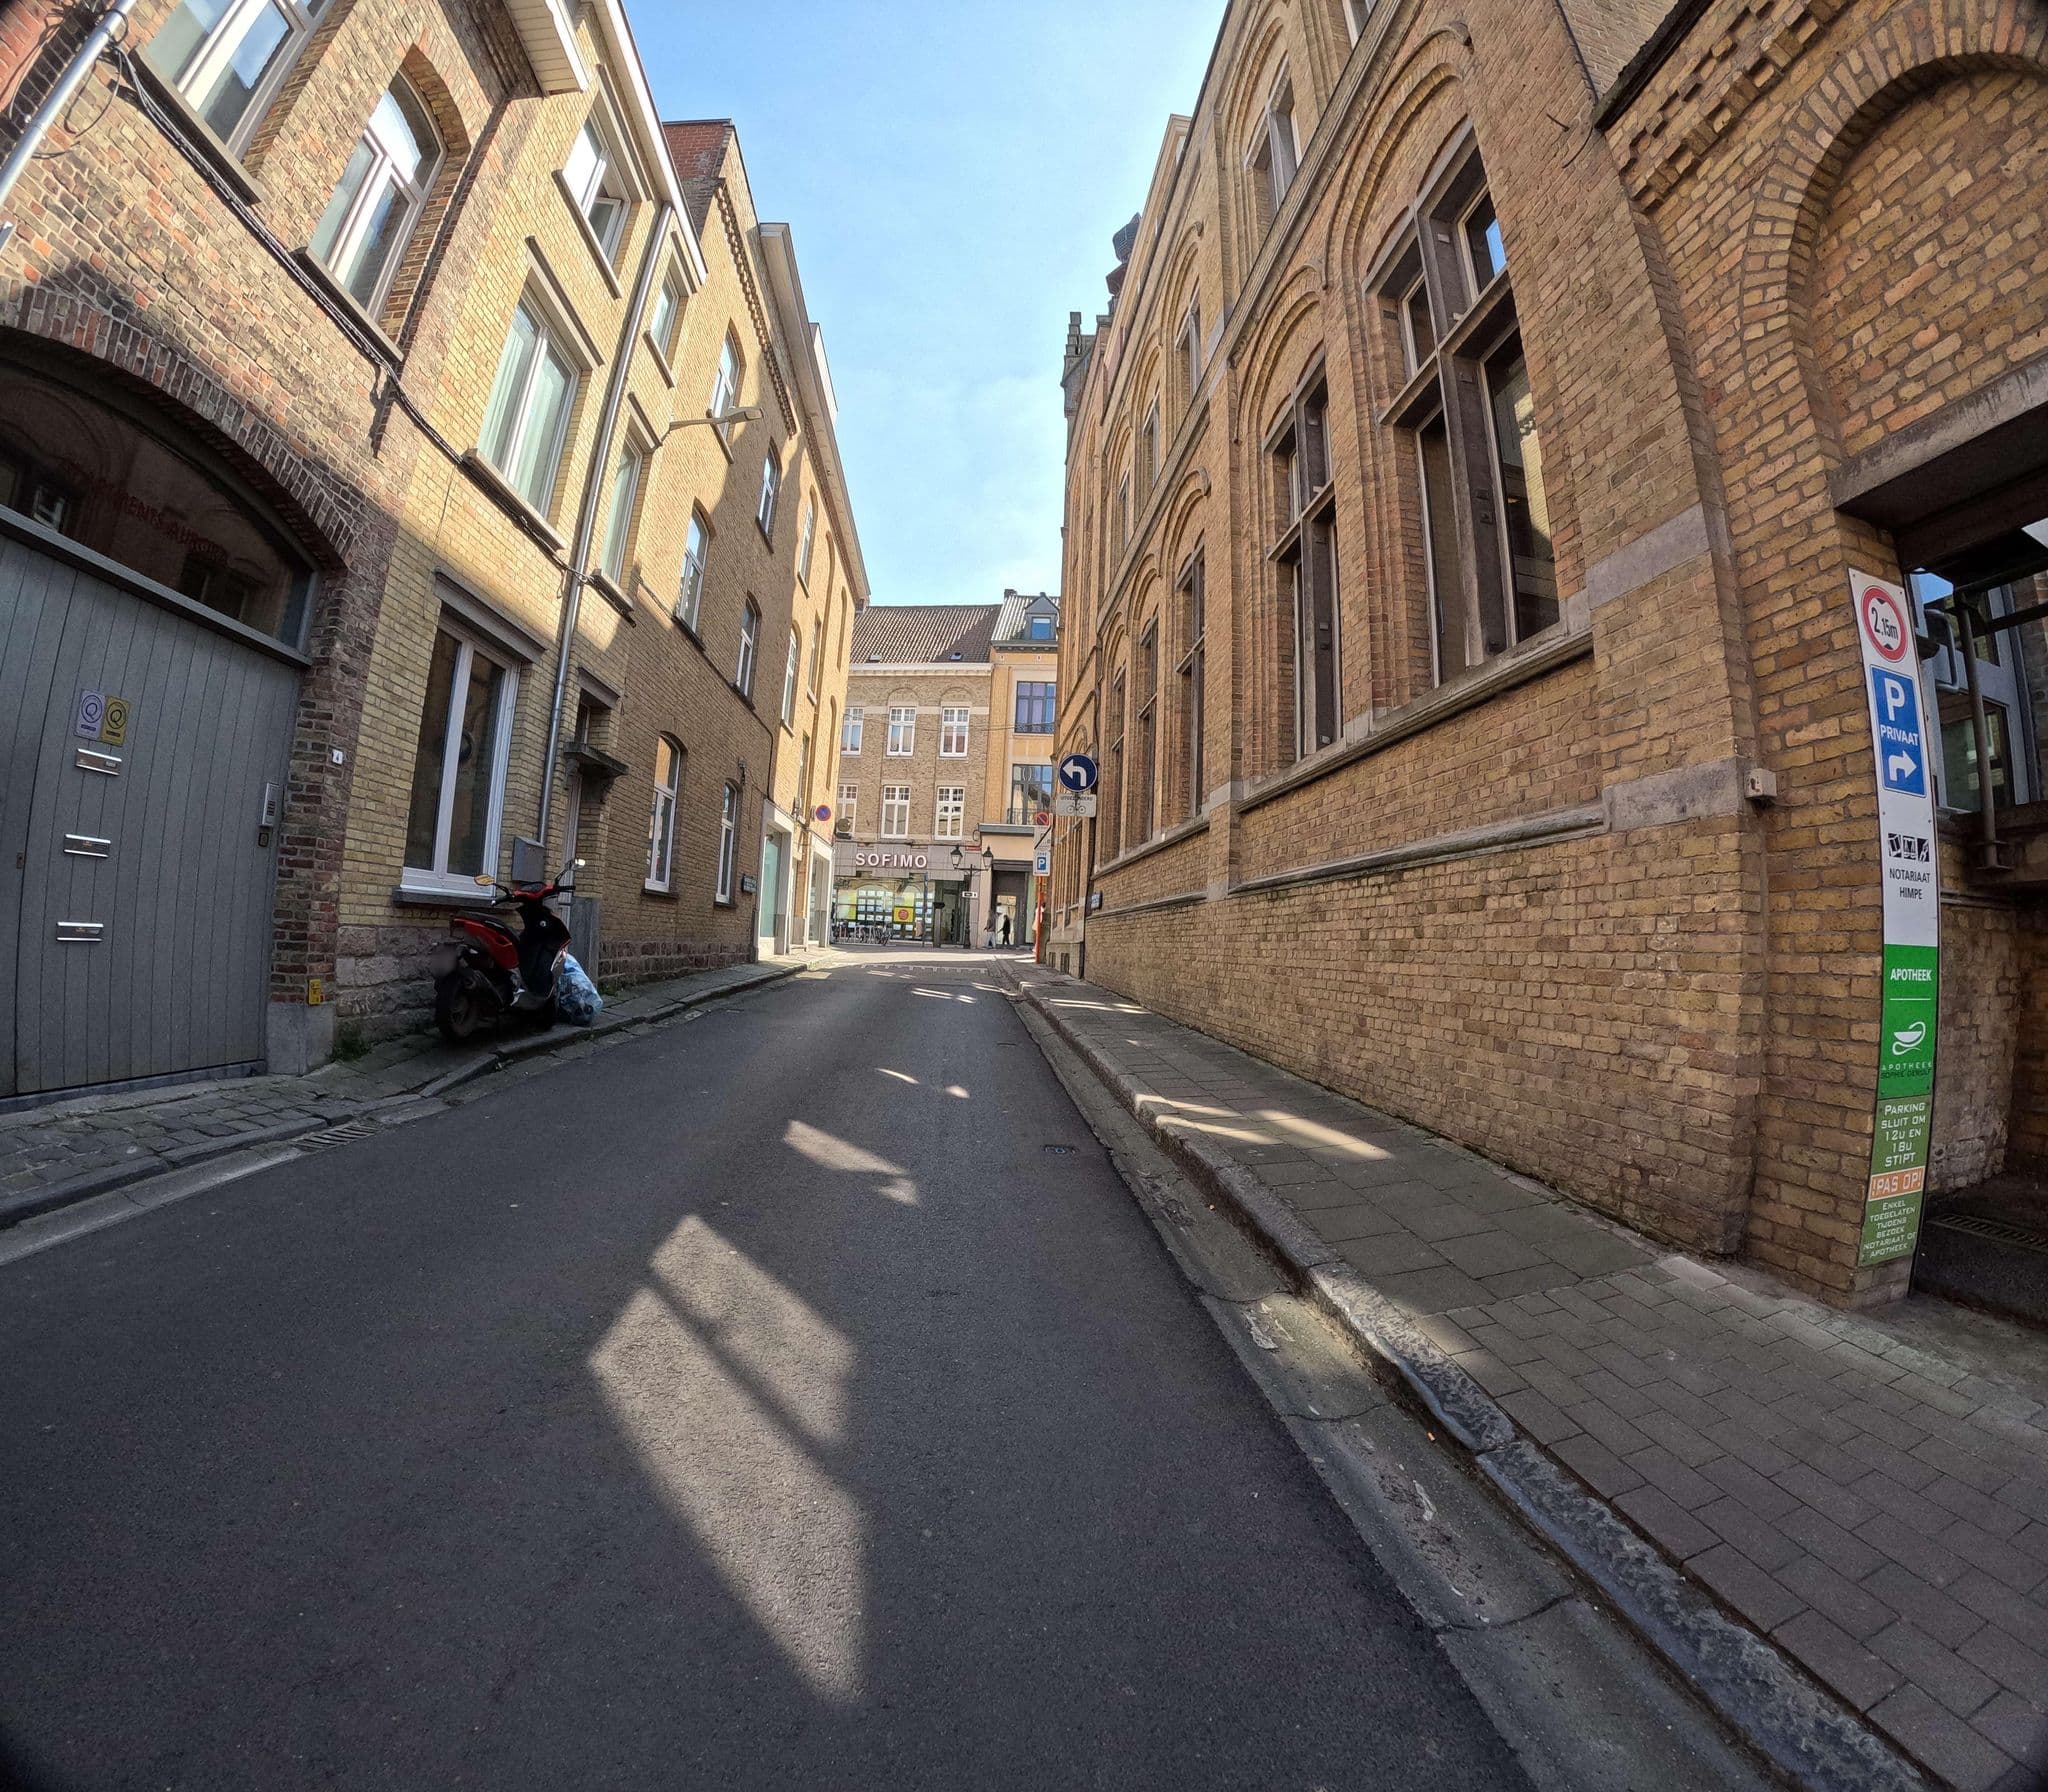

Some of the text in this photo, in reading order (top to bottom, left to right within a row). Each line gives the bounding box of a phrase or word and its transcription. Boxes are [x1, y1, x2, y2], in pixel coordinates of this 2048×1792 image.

[1884, 677, 1905, 721] P
[1880, 723, 1919, 746] PRIVAAT
[855, 852, 927, 868] SOFIMO
[1889, 868, 1931, 883] NOTARIAAT
[1899, 886, 1923, 900] HIMPE
[1890, 968, 1932, 982] APOTHEEK
[1884, 1102, 1926, 1116] PARKING
[1881, 1115, 1926, 1129] SLUIT OM
[1909, 1128, 1922, 1138] EN
[1884, 1152, 1916, 1167] STIPT
[1876, 1226, 1905, 1239] BEZOEK
[1864, 1235, 1905, 1250] NOTARIAAT
[1870, 1243, 1908, 1258] APOTHEEK
